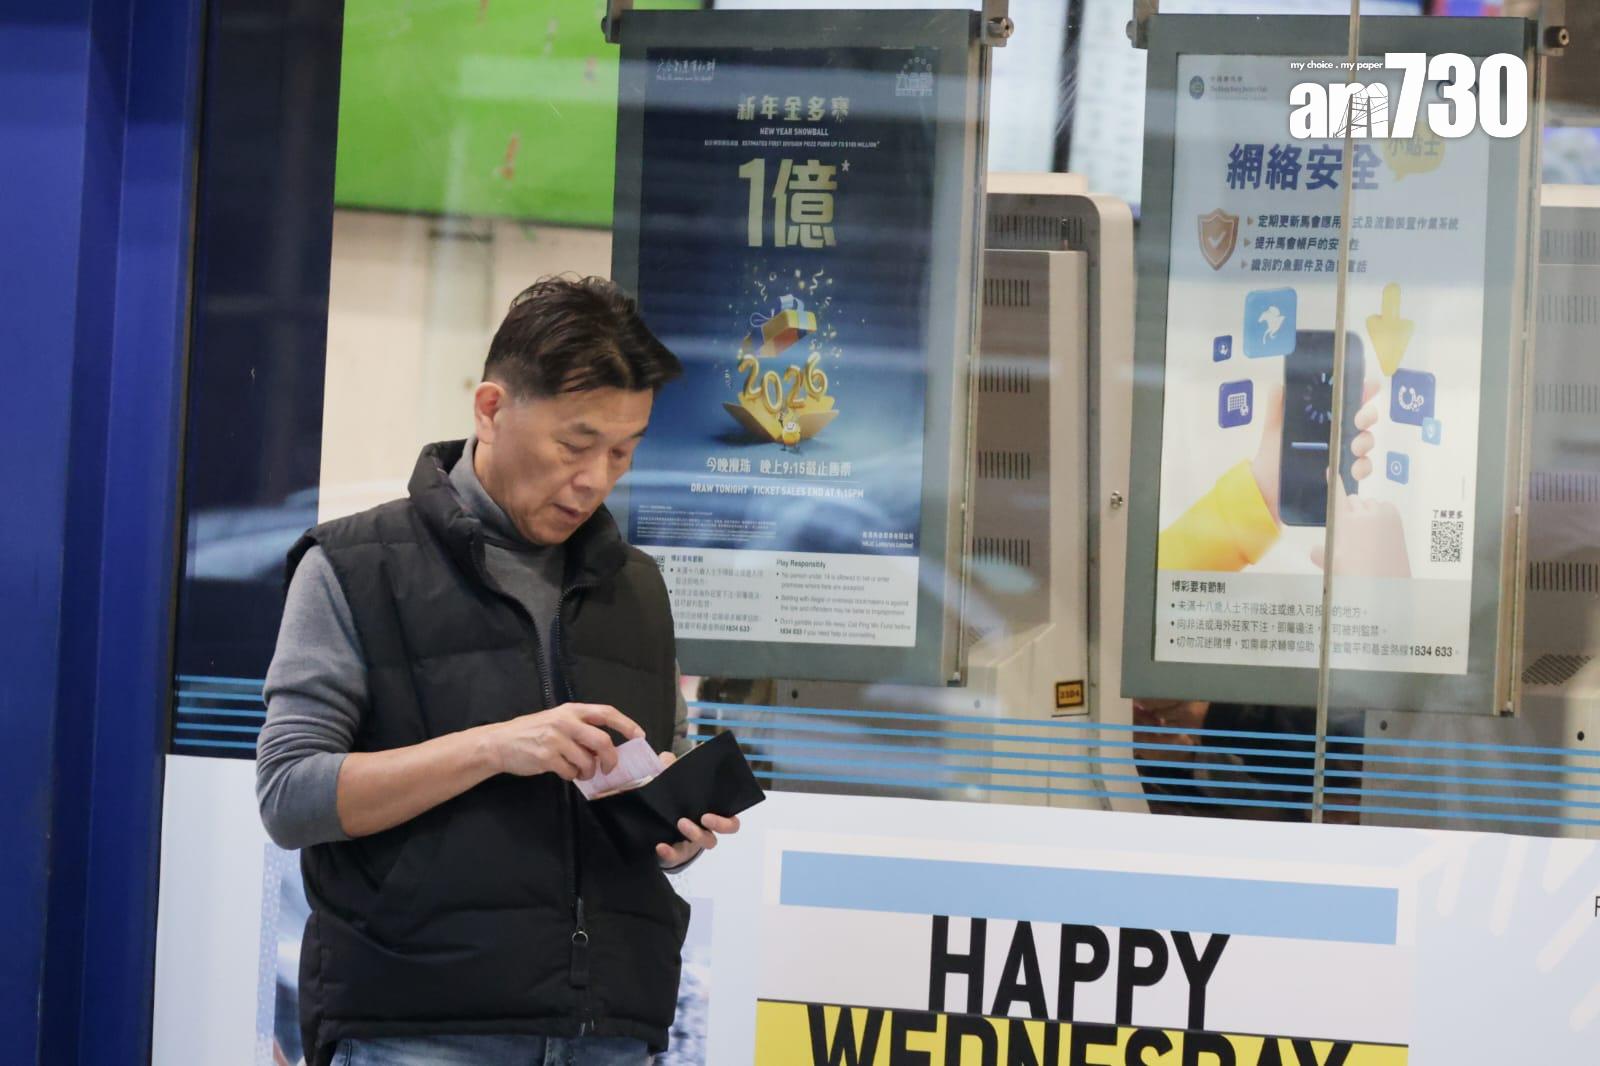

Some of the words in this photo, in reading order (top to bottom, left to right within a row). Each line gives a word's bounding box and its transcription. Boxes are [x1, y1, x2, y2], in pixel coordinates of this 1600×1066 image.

[760, 127, 775, 136] NEW
[776, 127, 793, 136] YEAR
[794, 127, 829, 137] SNOWBALL
[1226, 143, 1382, 191] 網絡安全
[1254, 236, 1360, 251] 提升馬會帳戶的安性
[738, 351, 828, 414] 2026
[690, 483, 714, 493] DRAW
[715, 484, 748, 494] TONIGHT
[753, 485, 780, 496] TICKET
[1171, 580, 1226, 594] 博彩要有節制
[1177, 600, 1367, 618] 未滿十八歲人士不得投注或進入可投的地方。
[1176, 618, 1387, 636] 向非法或海外莊家下注，即屬違法，可被判監禁。
[928, 915, 1230, 1030] HAPPY
